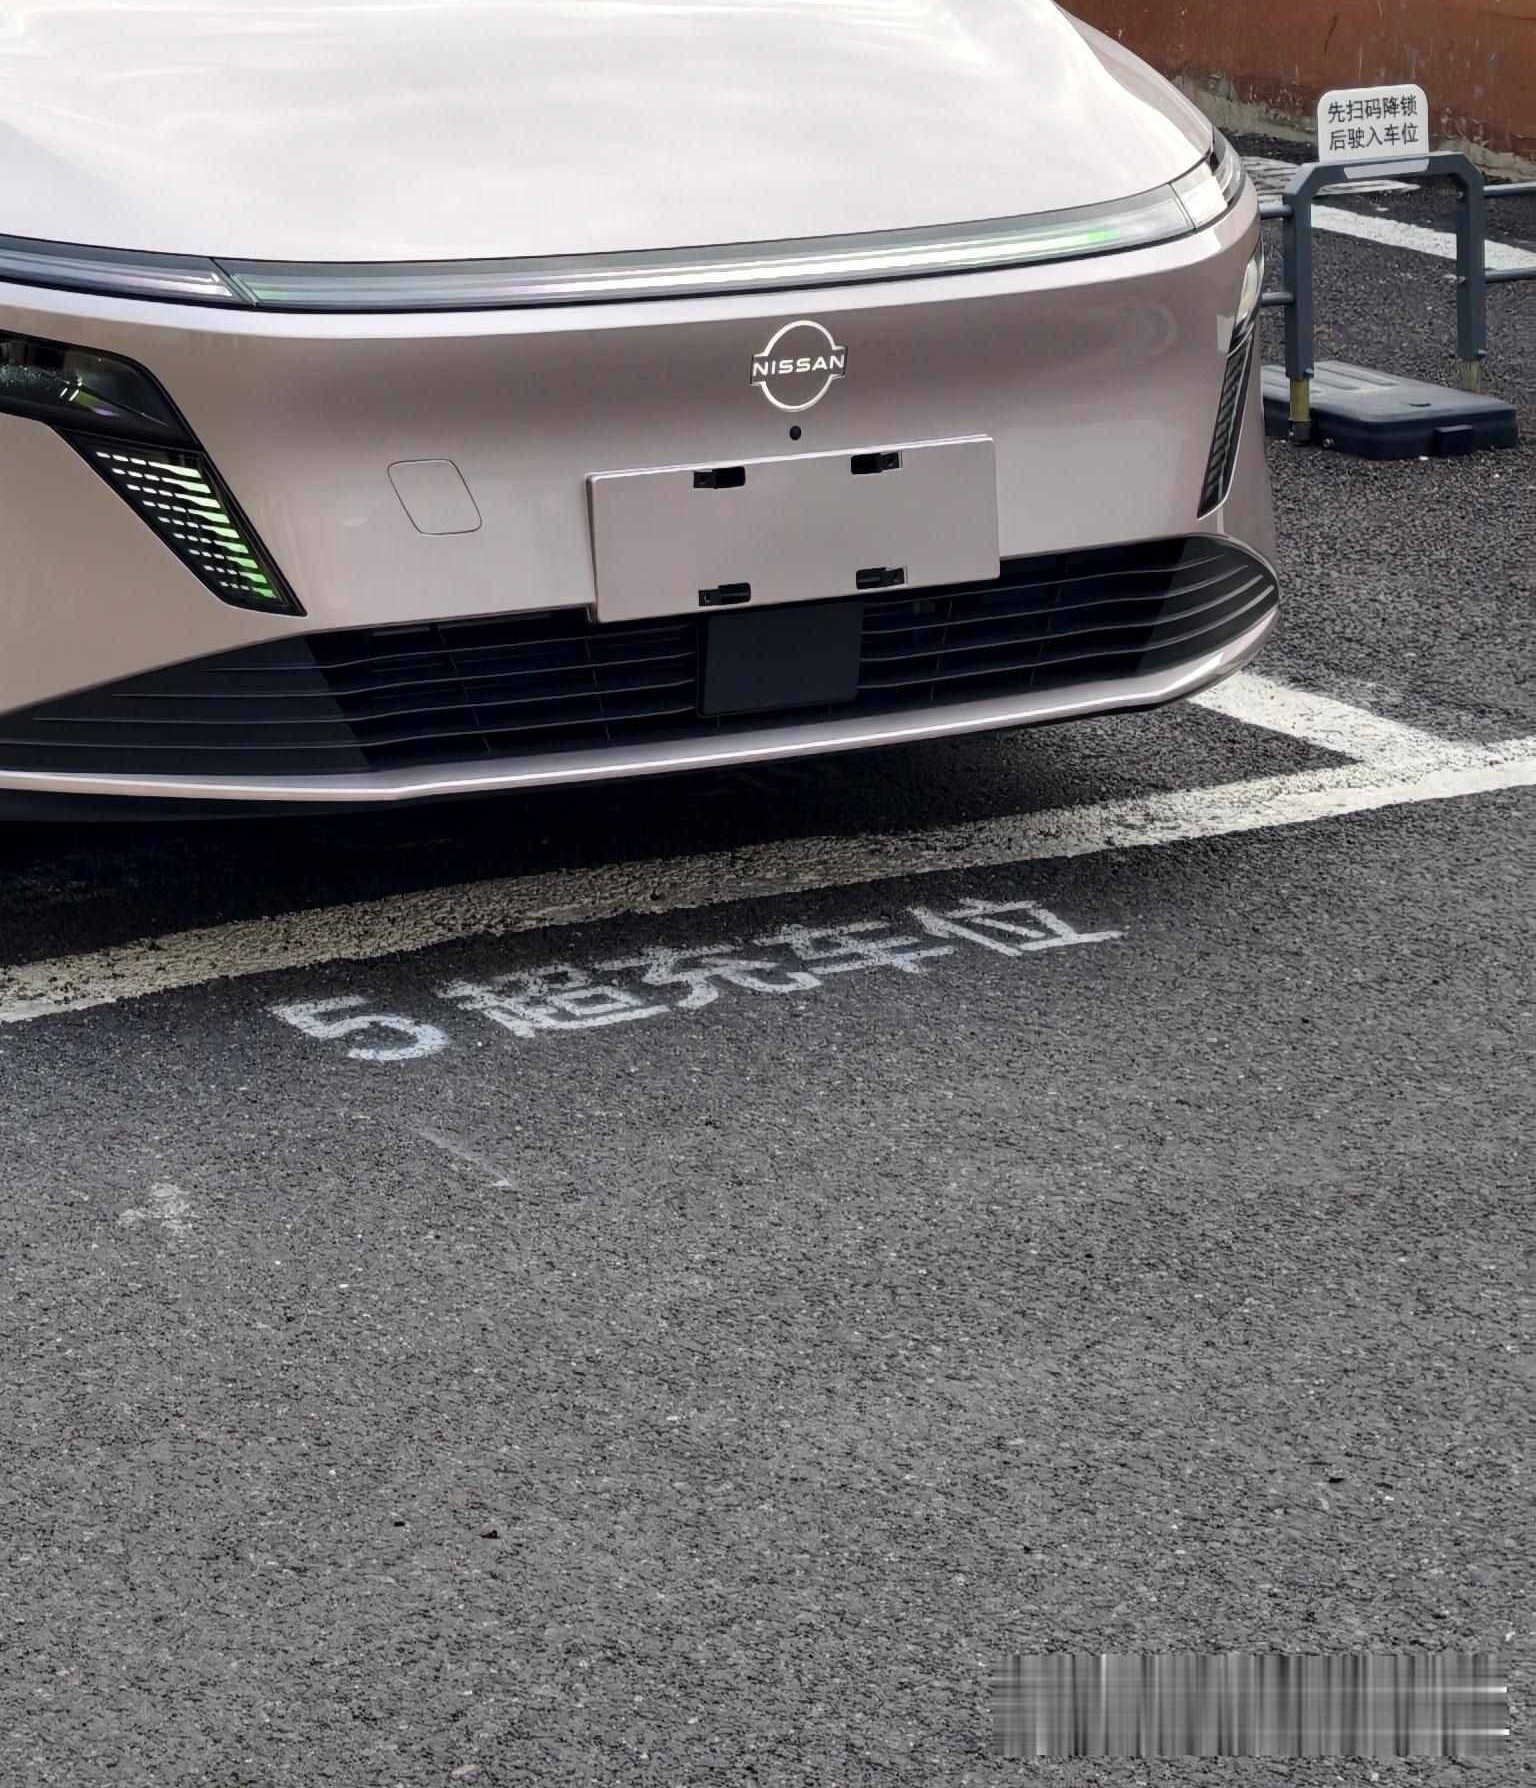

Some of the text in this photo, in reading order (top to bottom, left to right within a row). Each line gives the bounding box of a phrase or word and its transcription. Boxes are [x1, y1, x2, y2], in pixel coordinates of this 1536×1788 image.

[1327, 94, 1418, 124] 先扫码降锁
[1329, 122, 1419, 151] 后驶入车位
[752, 353, 845, 377] NISSAN
